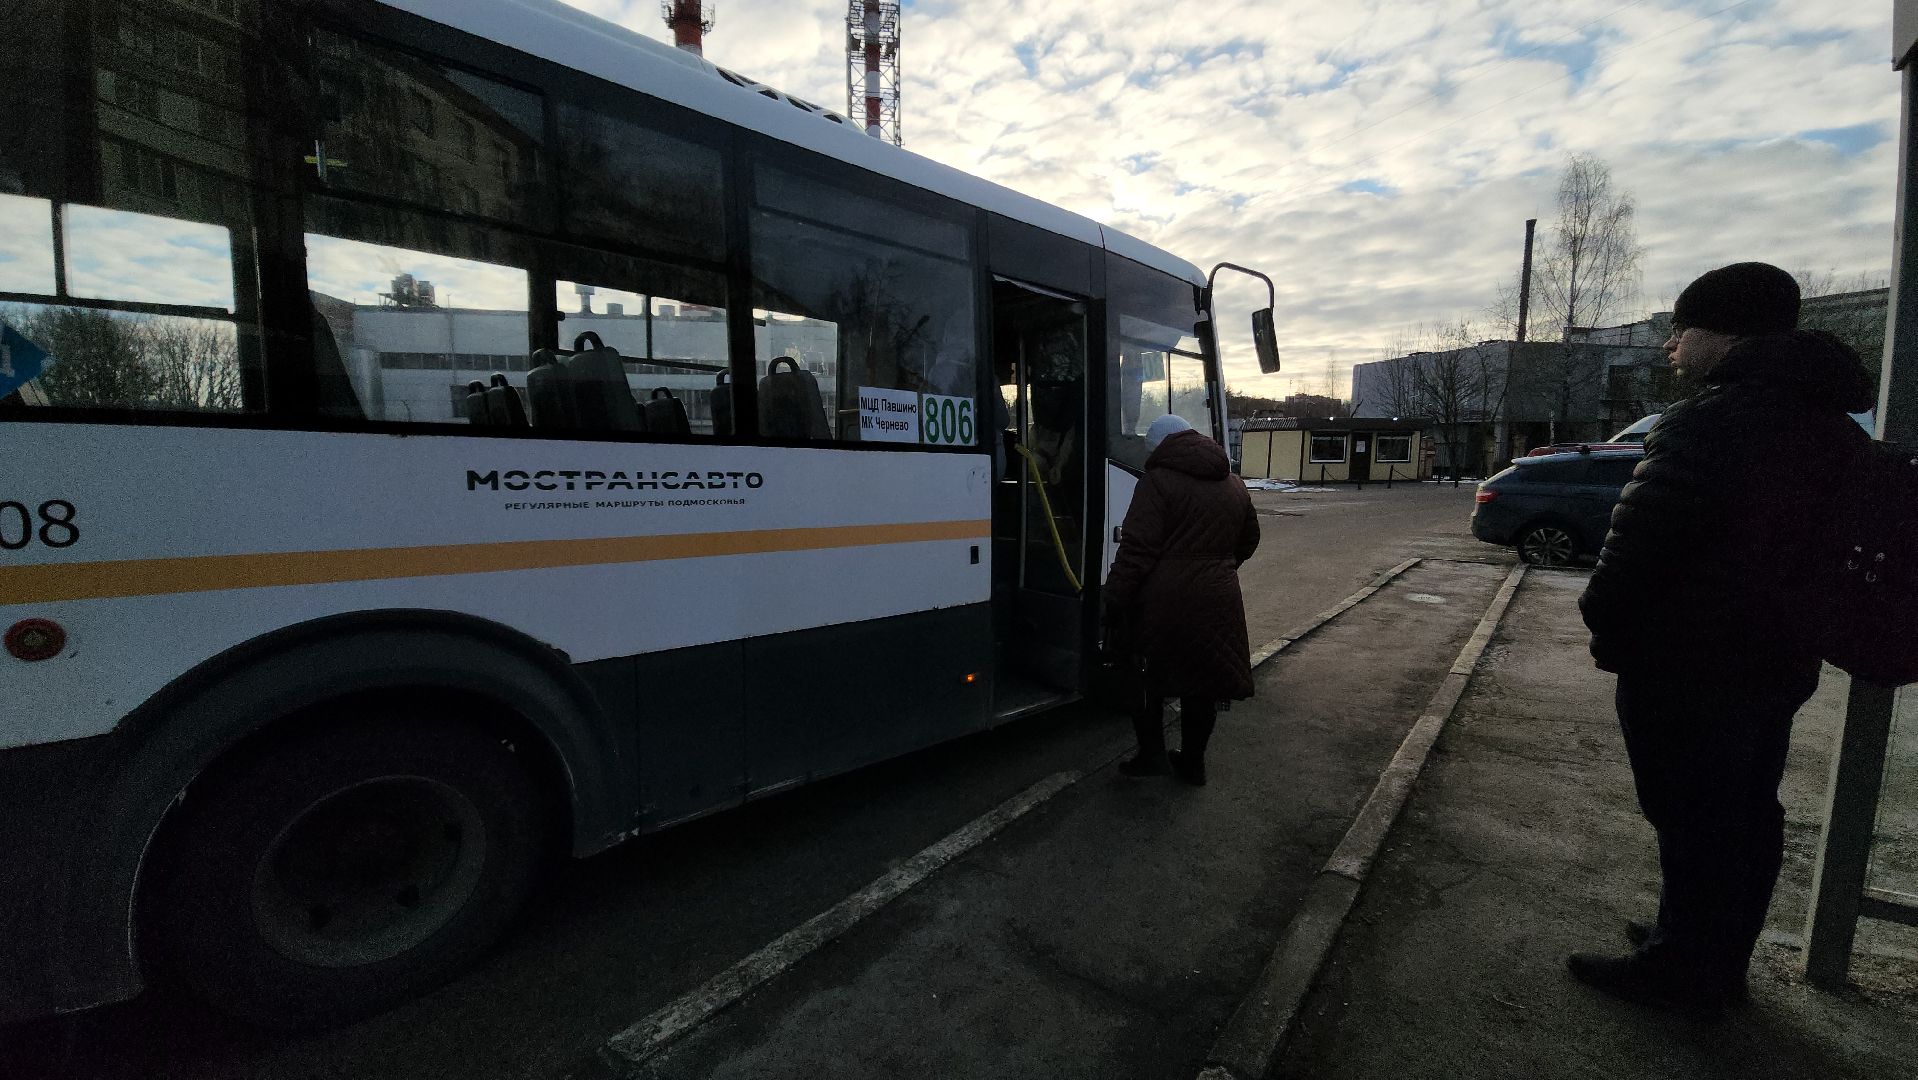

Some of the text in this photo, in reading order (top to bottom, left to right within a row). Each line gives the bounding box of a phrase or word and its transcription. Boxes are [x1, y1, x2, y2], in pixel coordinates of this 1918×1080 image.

[861, 397, 917, 414] МЦД Павшино
[861, 416, 909, 433] МК Чернево
[925, 397, 973, 444] 806
[466, 470, 763, 491] МОСТРАНСАВТО
[504, 498, 745, 510] РЕГУЛЯРНЫЕ МАРШРУТЫ ПОДМОСКОВЬЯ
[0, 499, 80, 549] 08
